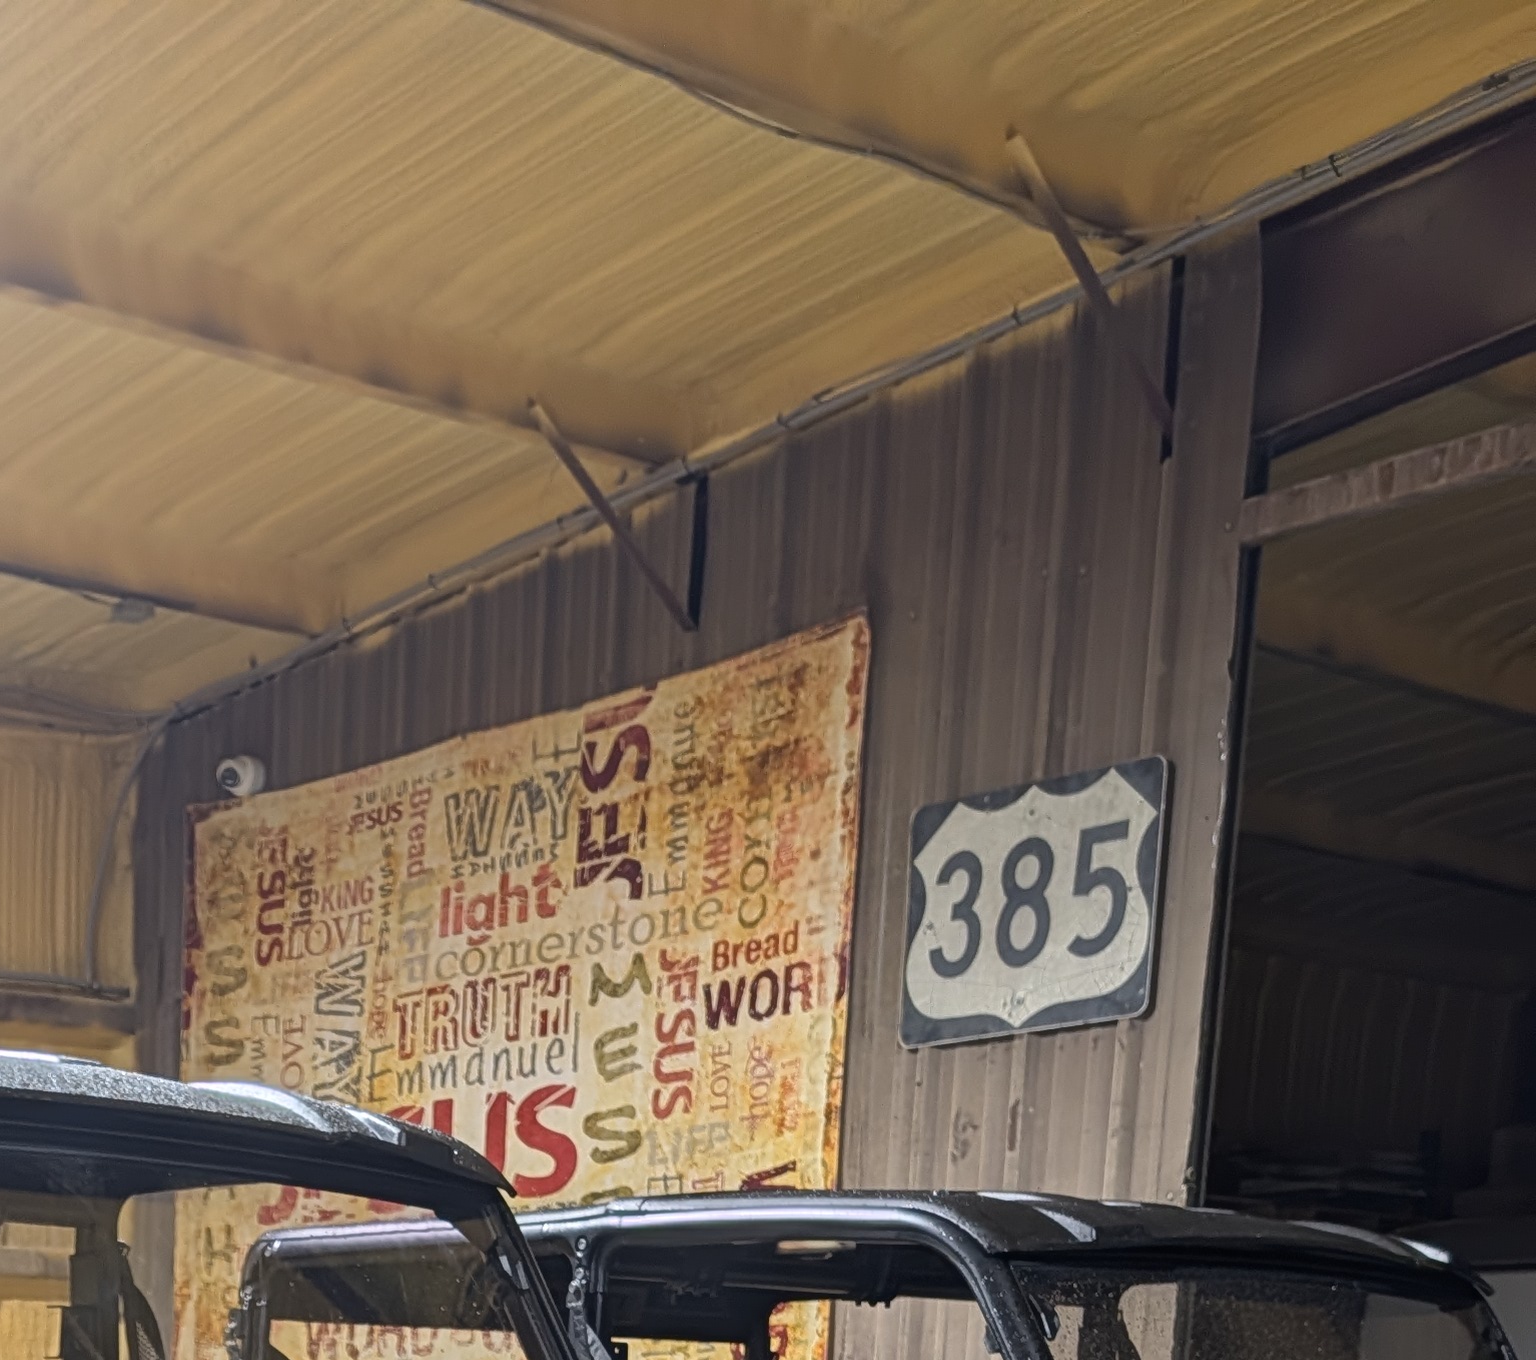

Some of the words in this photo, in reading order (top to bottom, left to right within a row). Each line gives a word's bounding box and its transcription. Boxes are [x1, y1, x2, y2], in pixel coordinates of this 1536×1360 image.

[444, 765, 581, 862] WAY
[283, 908, 375, 961] LOVE
[320, 874, 376, 914] KING
[438, 863, 569, 947] light
[928, 819, 1129, 978] 385
[434, 898, 724, 980] cornerstone
[711, 927, 800, 973] Bread
[392, 964, 572, 1061] TRUTH
[366, 1010, 581, 1103] Emmanuel
[709, 1039, 732, 1112] LOVE
